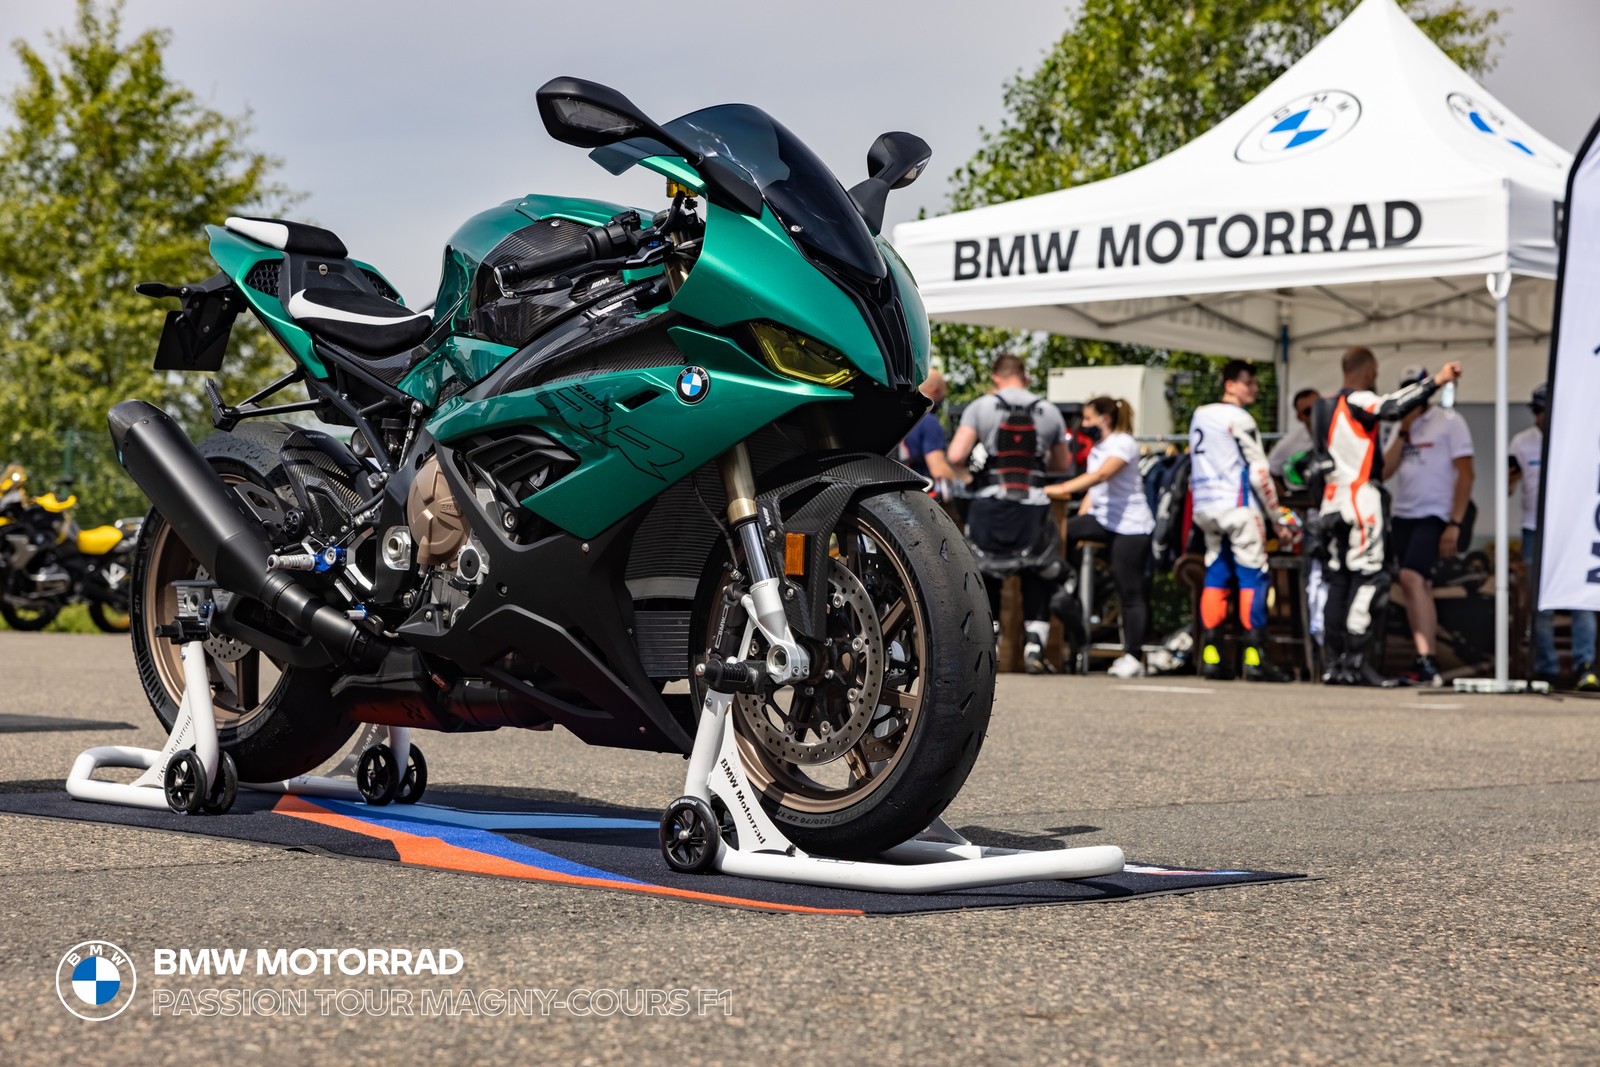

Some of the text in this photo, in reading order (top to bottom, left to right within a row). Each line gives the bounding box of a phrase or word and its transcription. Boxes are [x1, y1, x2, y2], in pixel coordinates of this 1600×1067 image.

[954, 200, 1422, 281] BMW MOTORRAD
[681, 366, 708, 381] BMW
[720, 758, 767, 845] BMW Motorrad
